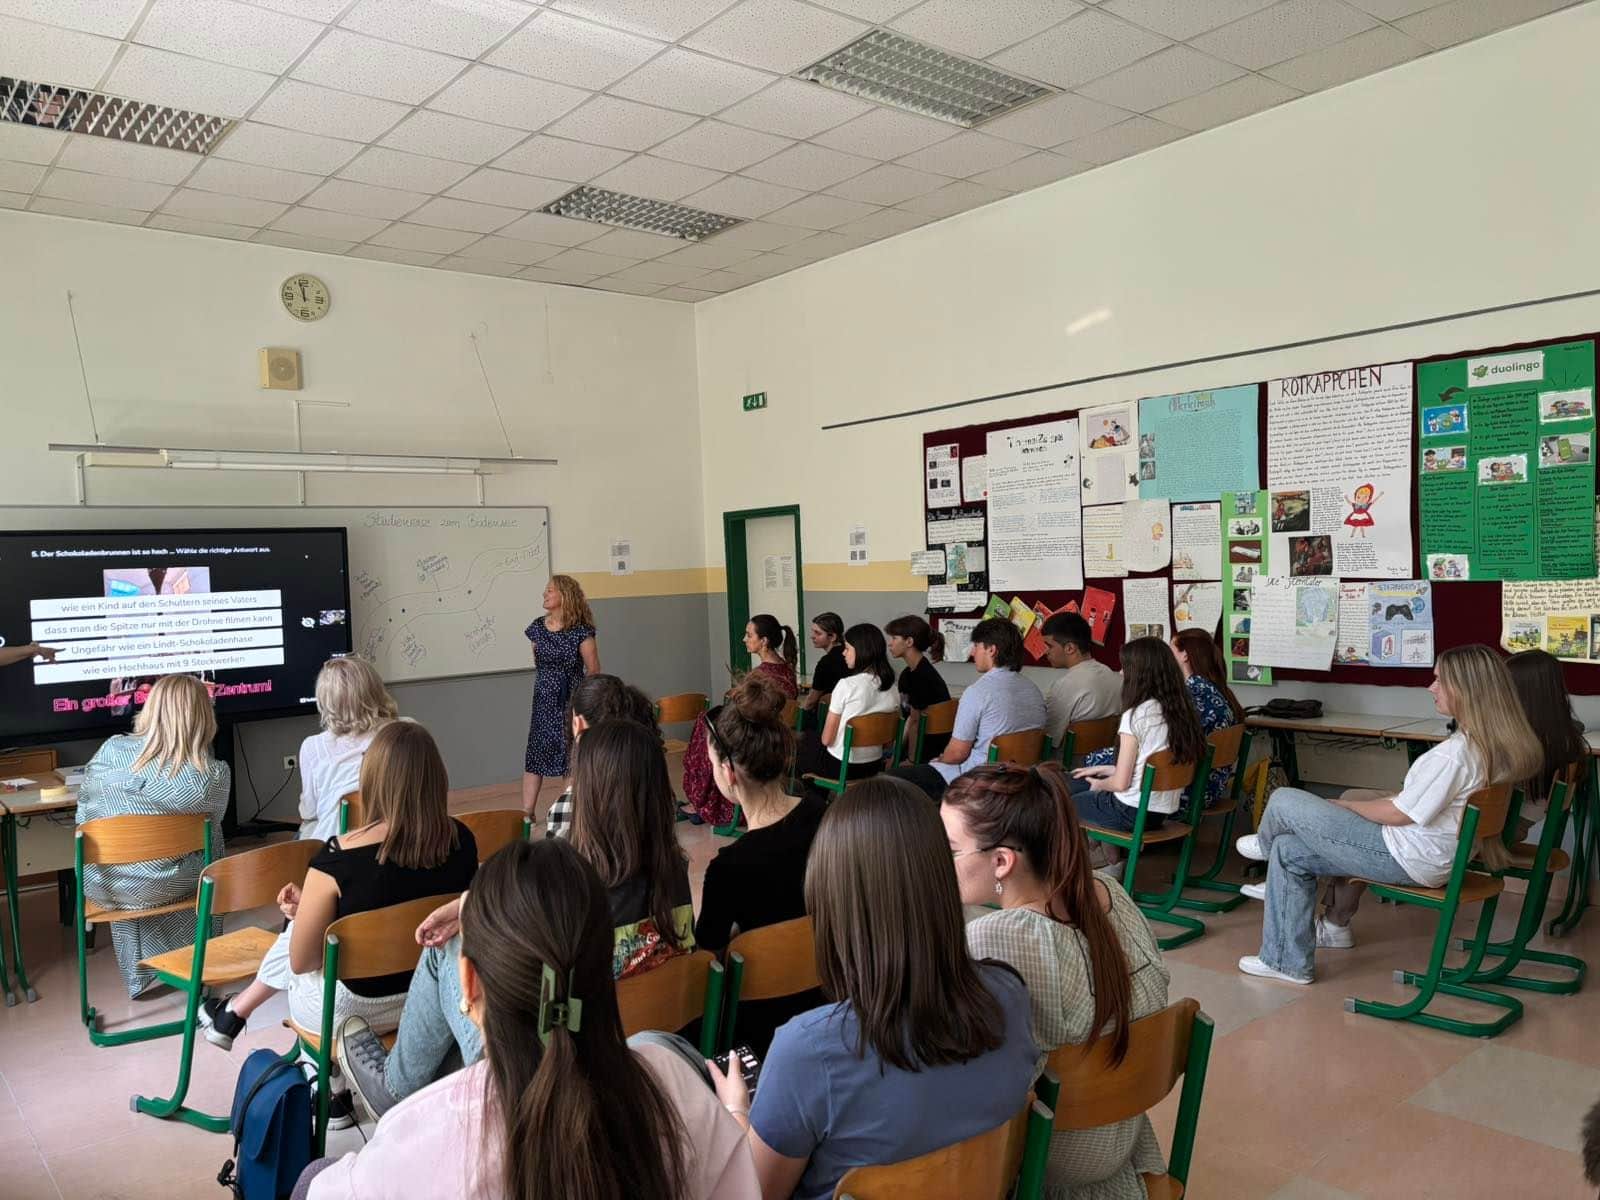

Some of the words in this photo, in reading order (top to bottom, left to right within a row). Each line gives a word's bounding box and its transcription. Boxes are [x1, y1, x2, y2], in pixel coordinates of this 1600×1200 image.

[1491, 361, 1540, 374] duolingo
[132, 548, 141, 556] ist
[209, 546, 232, 555] richtige
[61, 603, 79, 612] wie
[81, 603, 96, 612] ein
[98, 601, 119, 610] Kind
[122, 601, 137, 609] auf
[138, 600, 156, 608] den
[158, 598, 200, 607] Schultern
[203, 597, 229, 606] seines
[230, 595, 257, 604] Vaters
[44, 626, 67, 635] dass
[70, 625, 91, 634] man
[93, 623, 107, 632] die
[110, 622, 138, 633] Spitze
[141, 621, 156, 629] nur
[158, 619, 173, 628] mit
[175, 619, 189, 627] der
[192, 617, 223, 626] Drohne
[225, 615, 251, 624] filmen
[252, 614, 273, 622] kann
[71, 645, 116, 655] Ungefähr
[118, 643, 134, 651] wie
[136, 642, 151, 650] ein
[153, 635, 253, 649] Lindt-Schokoladenhase
[82, 666, 99, 675] wie
[102, 664, 117, 673] ein
[118, 661, 164, 672] Hochhaus
[166, 659, 181, 668] mit
[183, 658, 189, 667] 9
[191, 655, 245, 666] Stockwerken
[53, 697, 79, 712] Ein
[81, 694, 132, 712] großer
[215, 679, 272, 697] Zentrum!
